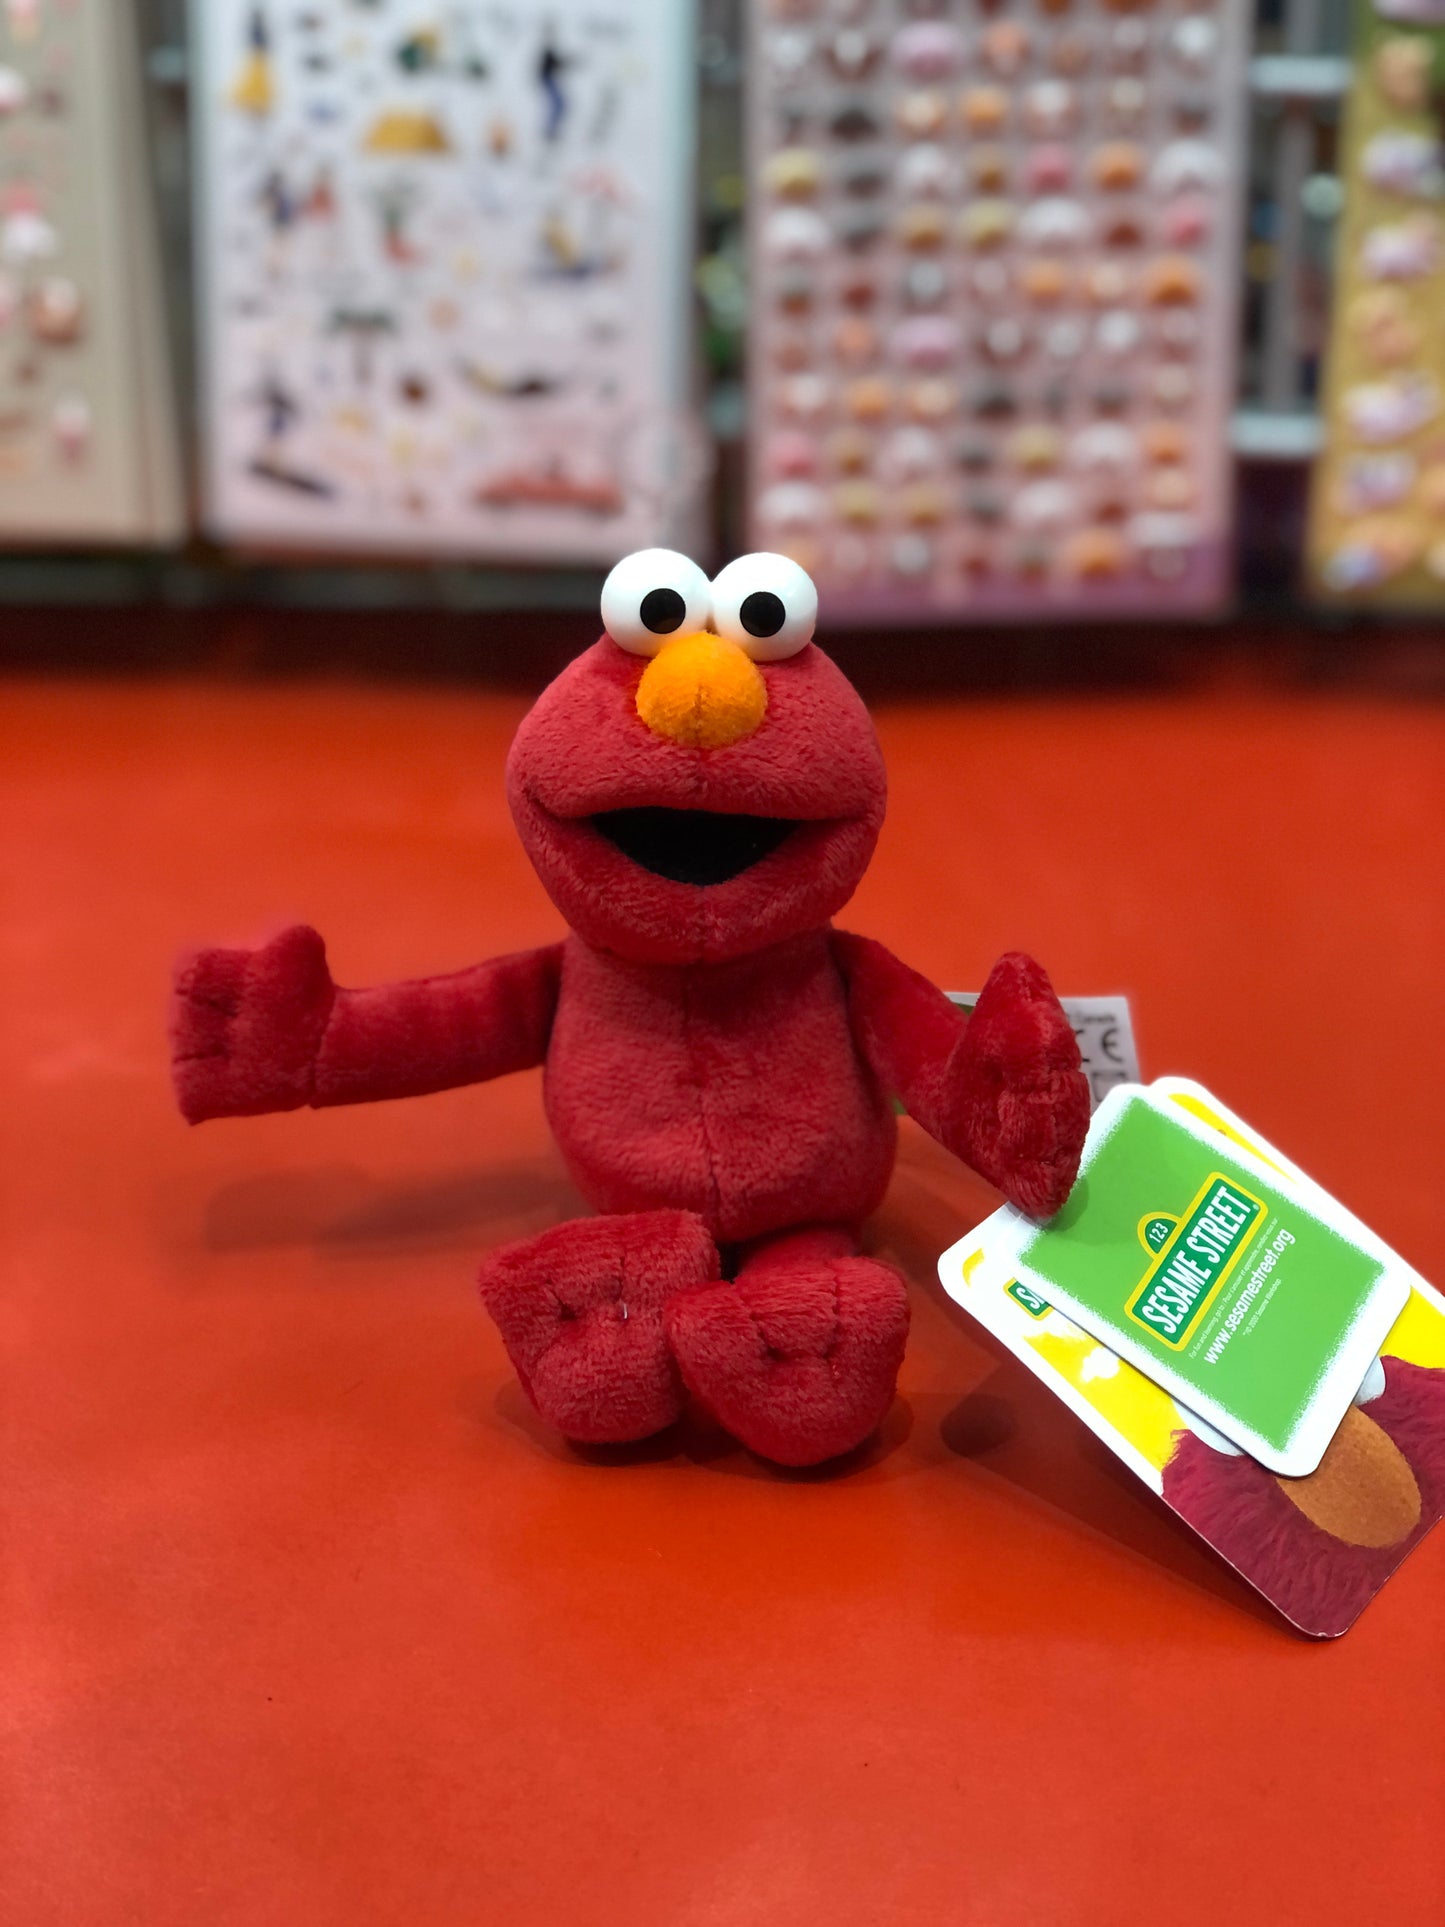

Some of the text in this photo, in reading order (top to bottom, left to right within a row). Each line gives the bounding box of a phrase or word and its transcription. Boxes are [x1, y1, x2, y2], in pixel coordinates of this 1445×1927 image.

[1142, 1186, 1251, 1333] SESAME STREET
[1150, 1223, 1168, 1242] 123
[1204, 1229, 1295, 1363] www.sesamestreet.org
